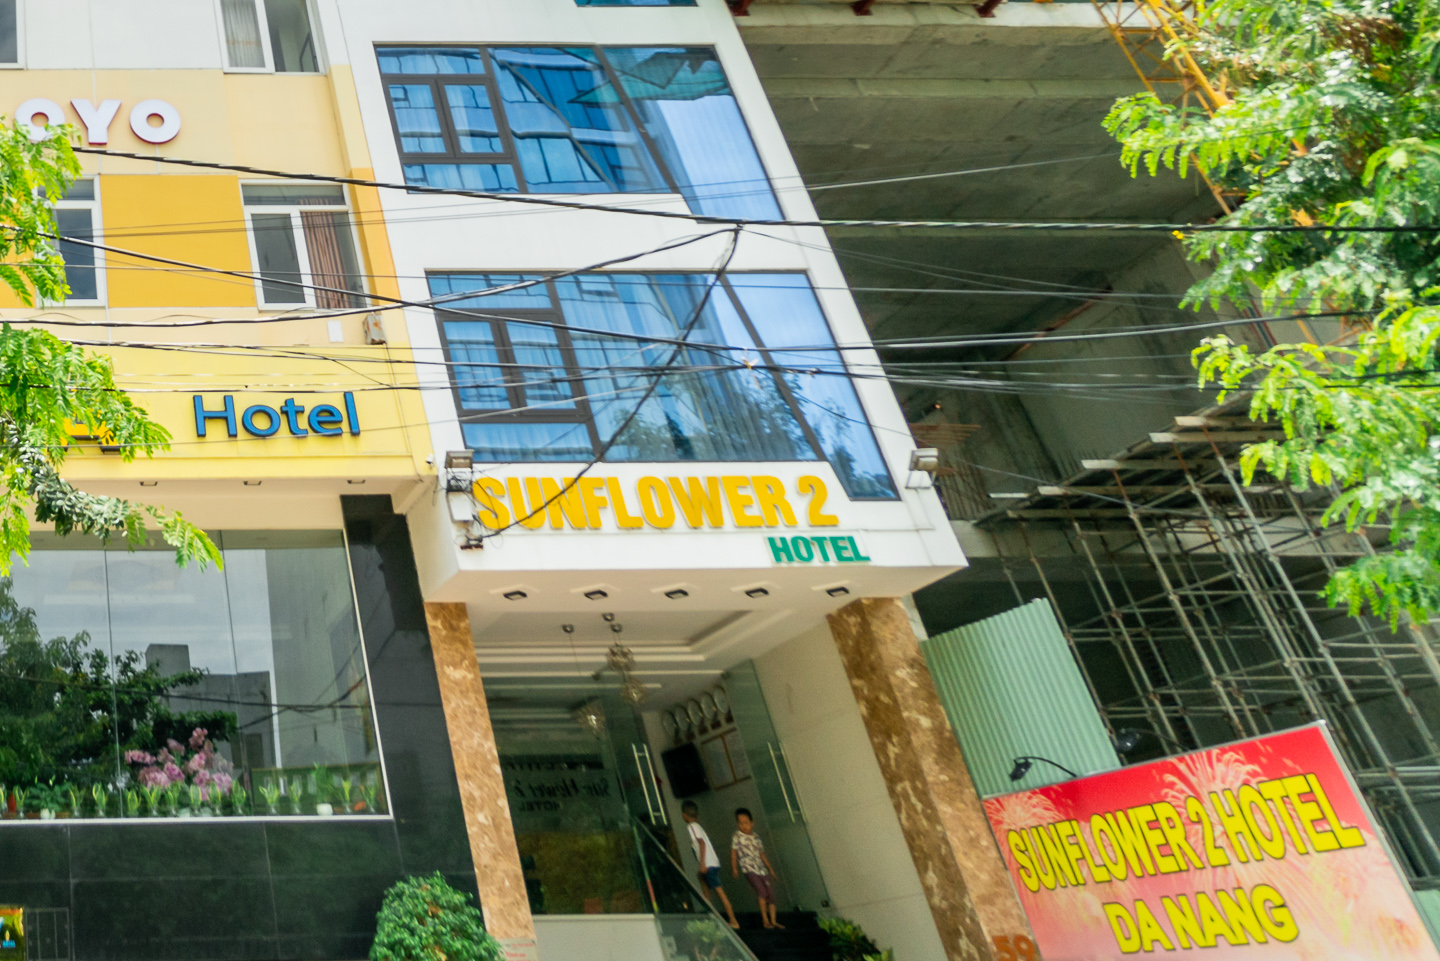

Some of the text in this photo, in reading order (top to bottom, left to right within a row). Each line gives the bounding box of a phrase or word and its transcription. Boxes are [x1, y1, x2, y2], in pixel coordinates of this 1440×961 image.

[14, 97, 182, 146] OYO
[192, 391, 361, 439] Hotel
[471, 475, 841, 531] SUNFLOWER 2
[767, 535, 873, 564] HOTEL
[1006, 772, 1367, 893] SUNFLOWER 2 HOTEL
[1101, 884, 1300, 954] DA NANG
